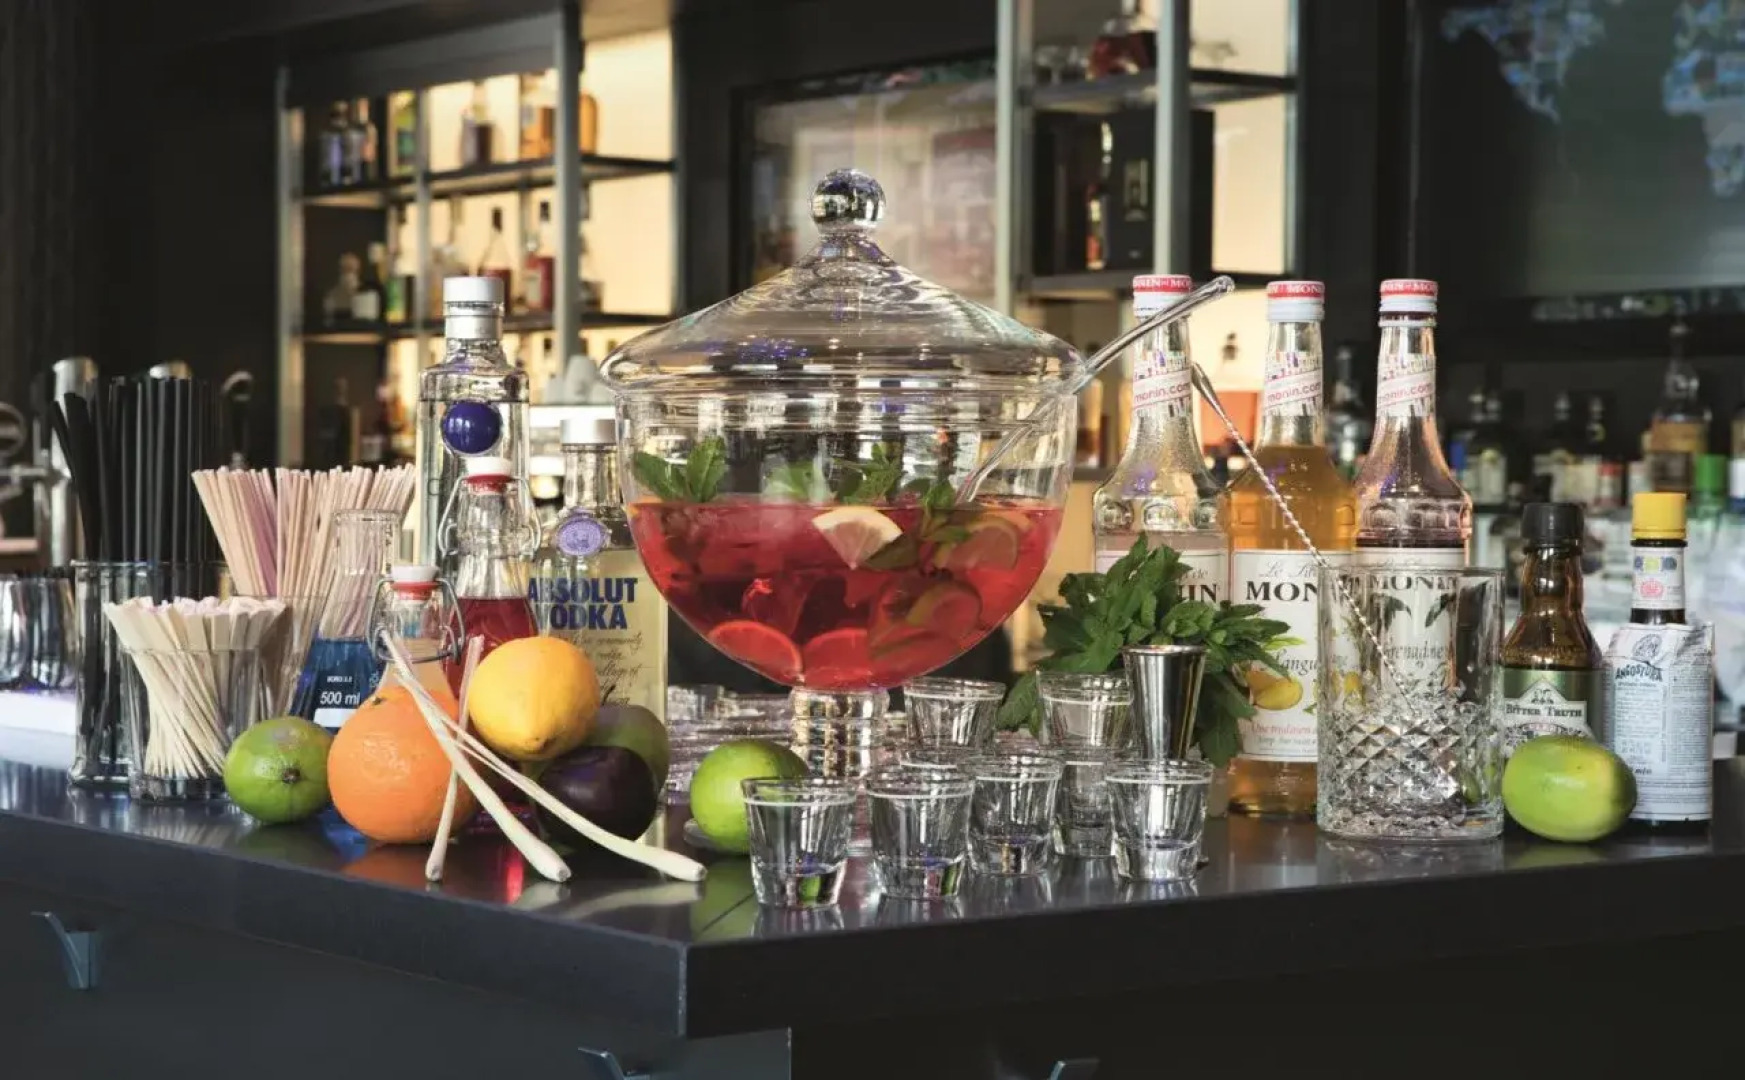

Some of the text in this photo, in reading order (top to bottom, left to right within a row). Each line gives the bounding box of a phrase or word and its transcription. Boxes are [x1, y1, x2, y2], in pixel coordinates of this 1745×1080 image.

[528, 577, 638, 603] ABSOLUT
[535, 603, 628, 630] VODKA
[1615, 663, 1662, 682] ANGOSTURA
[320, 691, 361, 706] 500 ml
